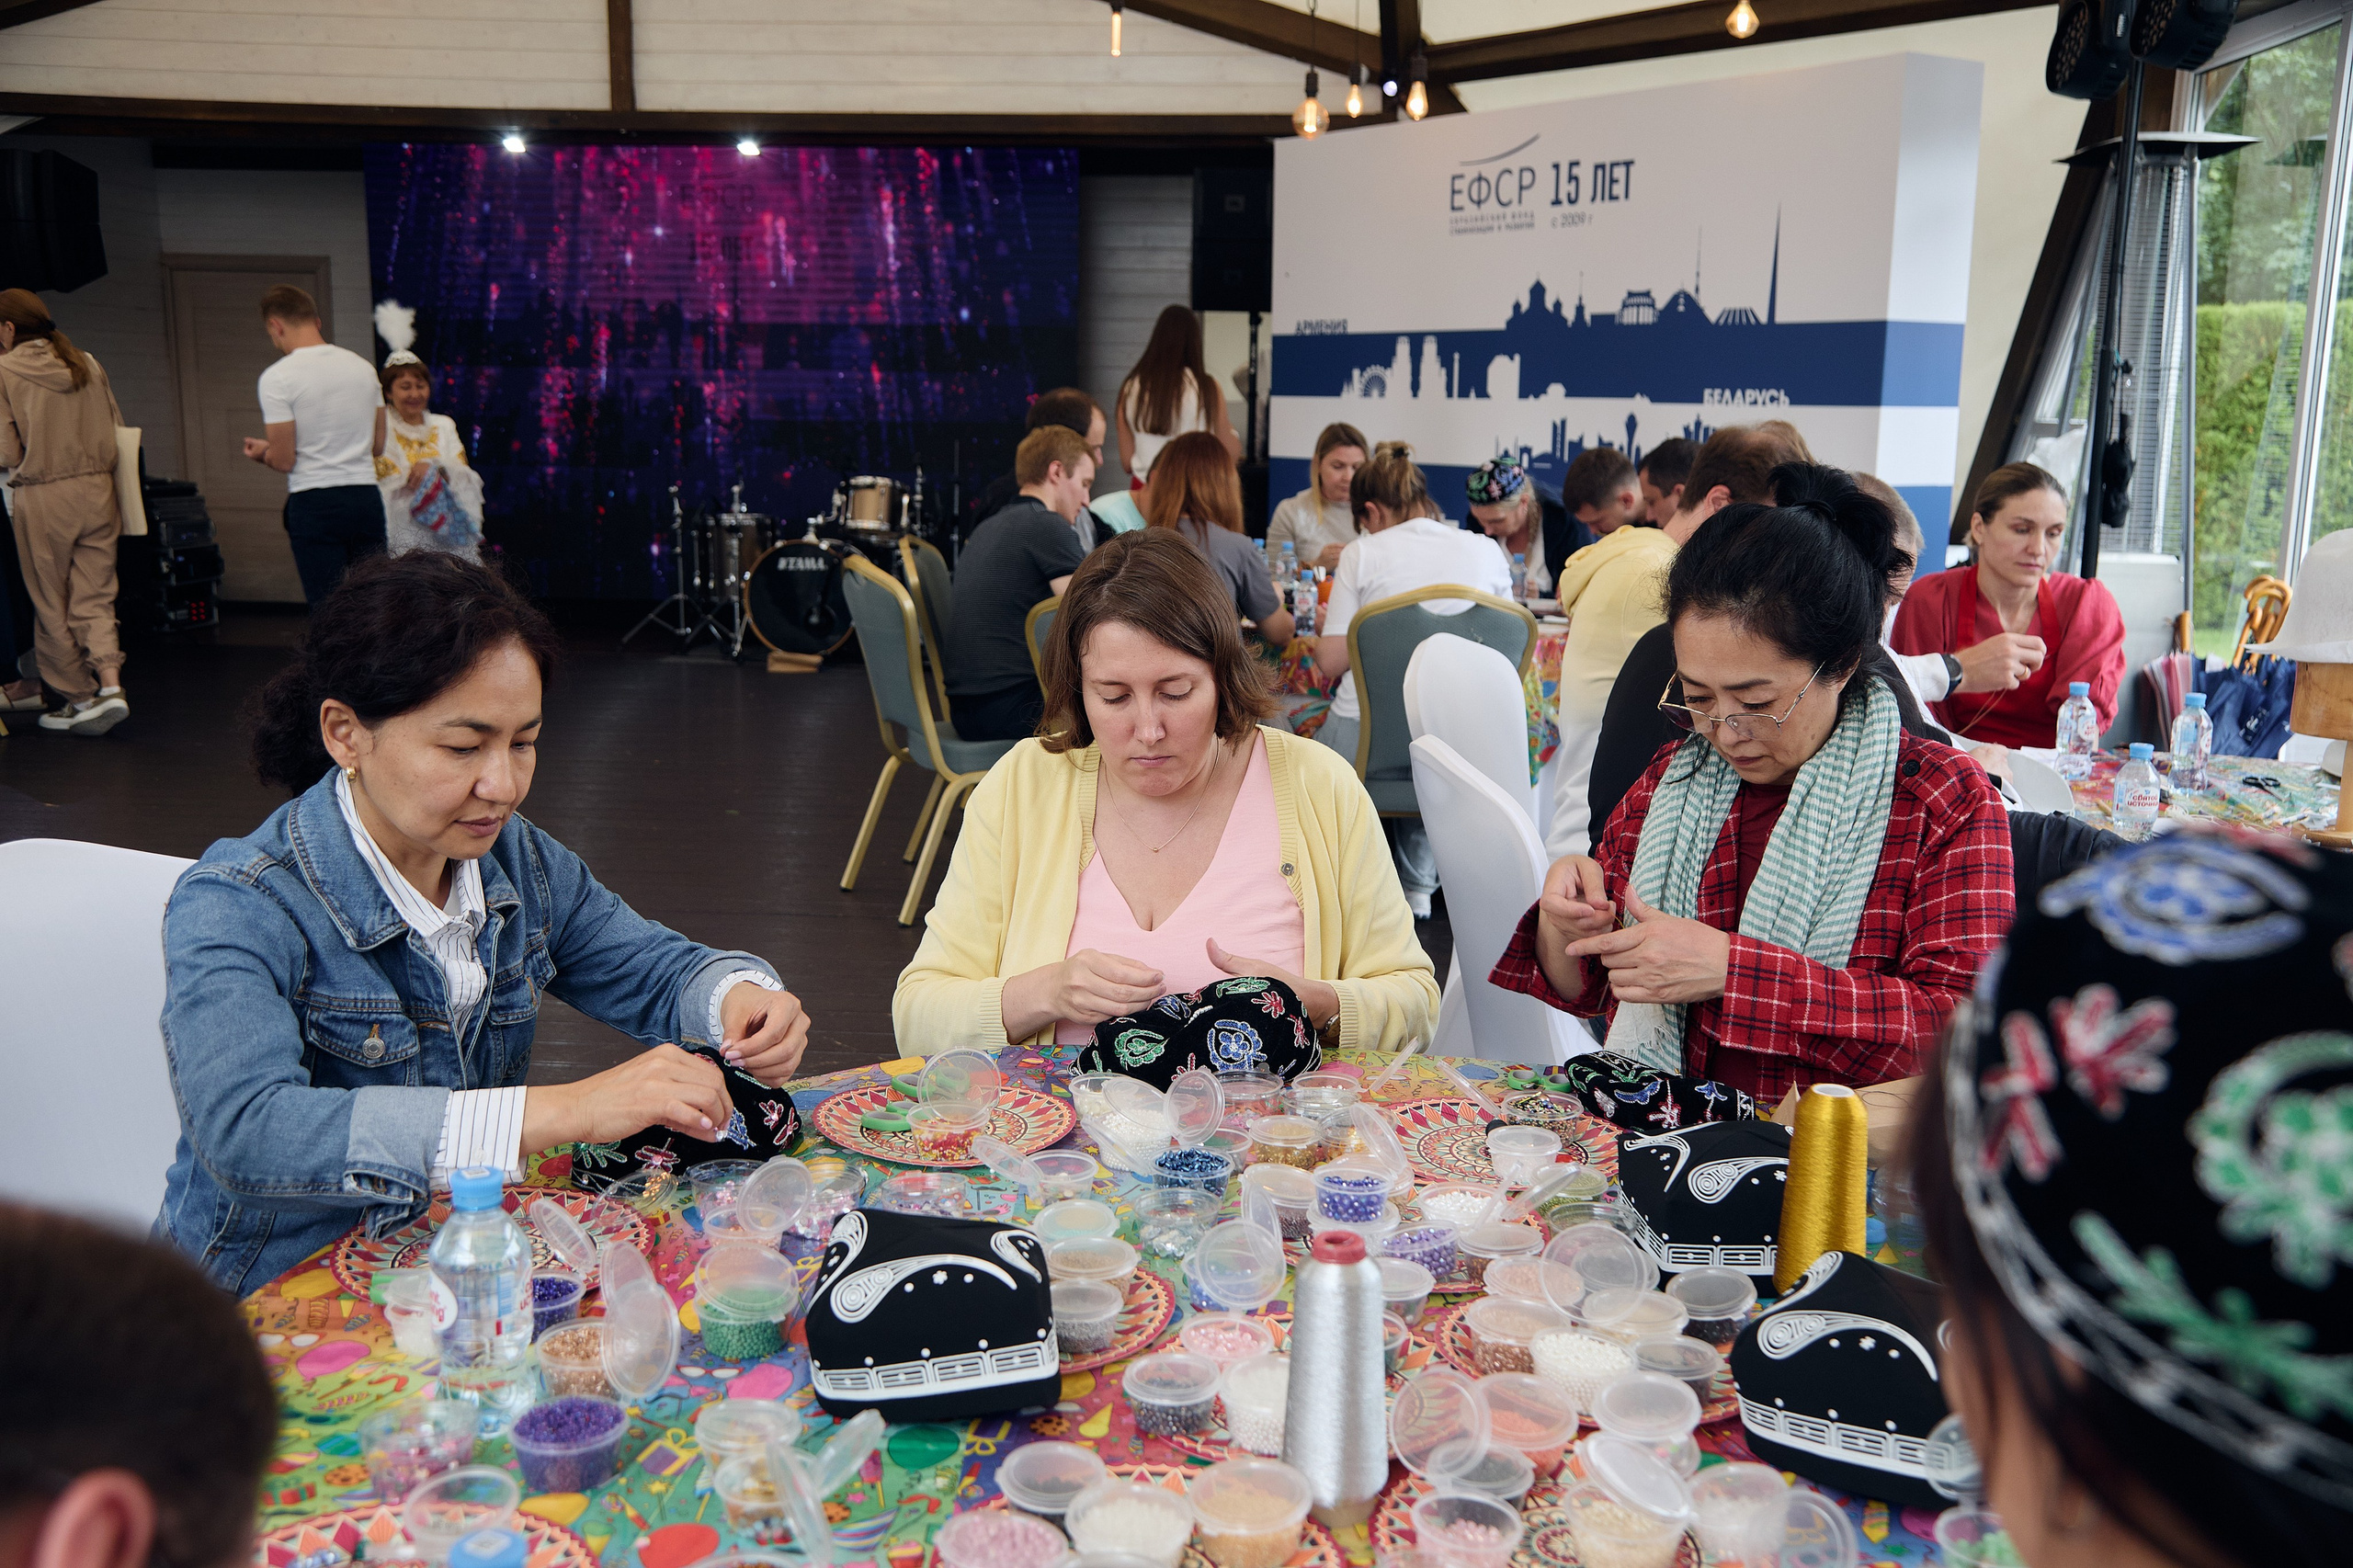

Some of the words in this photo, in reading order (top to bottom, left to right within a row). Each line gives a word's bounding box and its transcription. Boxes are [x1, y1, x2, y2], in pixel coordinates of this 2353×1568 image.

[1449, 166, 1536, 211] ЕФСР
[1551, 160, 1581, 206] 15
[1590, 158, 1635, 203] ЛЕТ
[1703, 388, 1790, 405] БЕЛАРУСЬ
